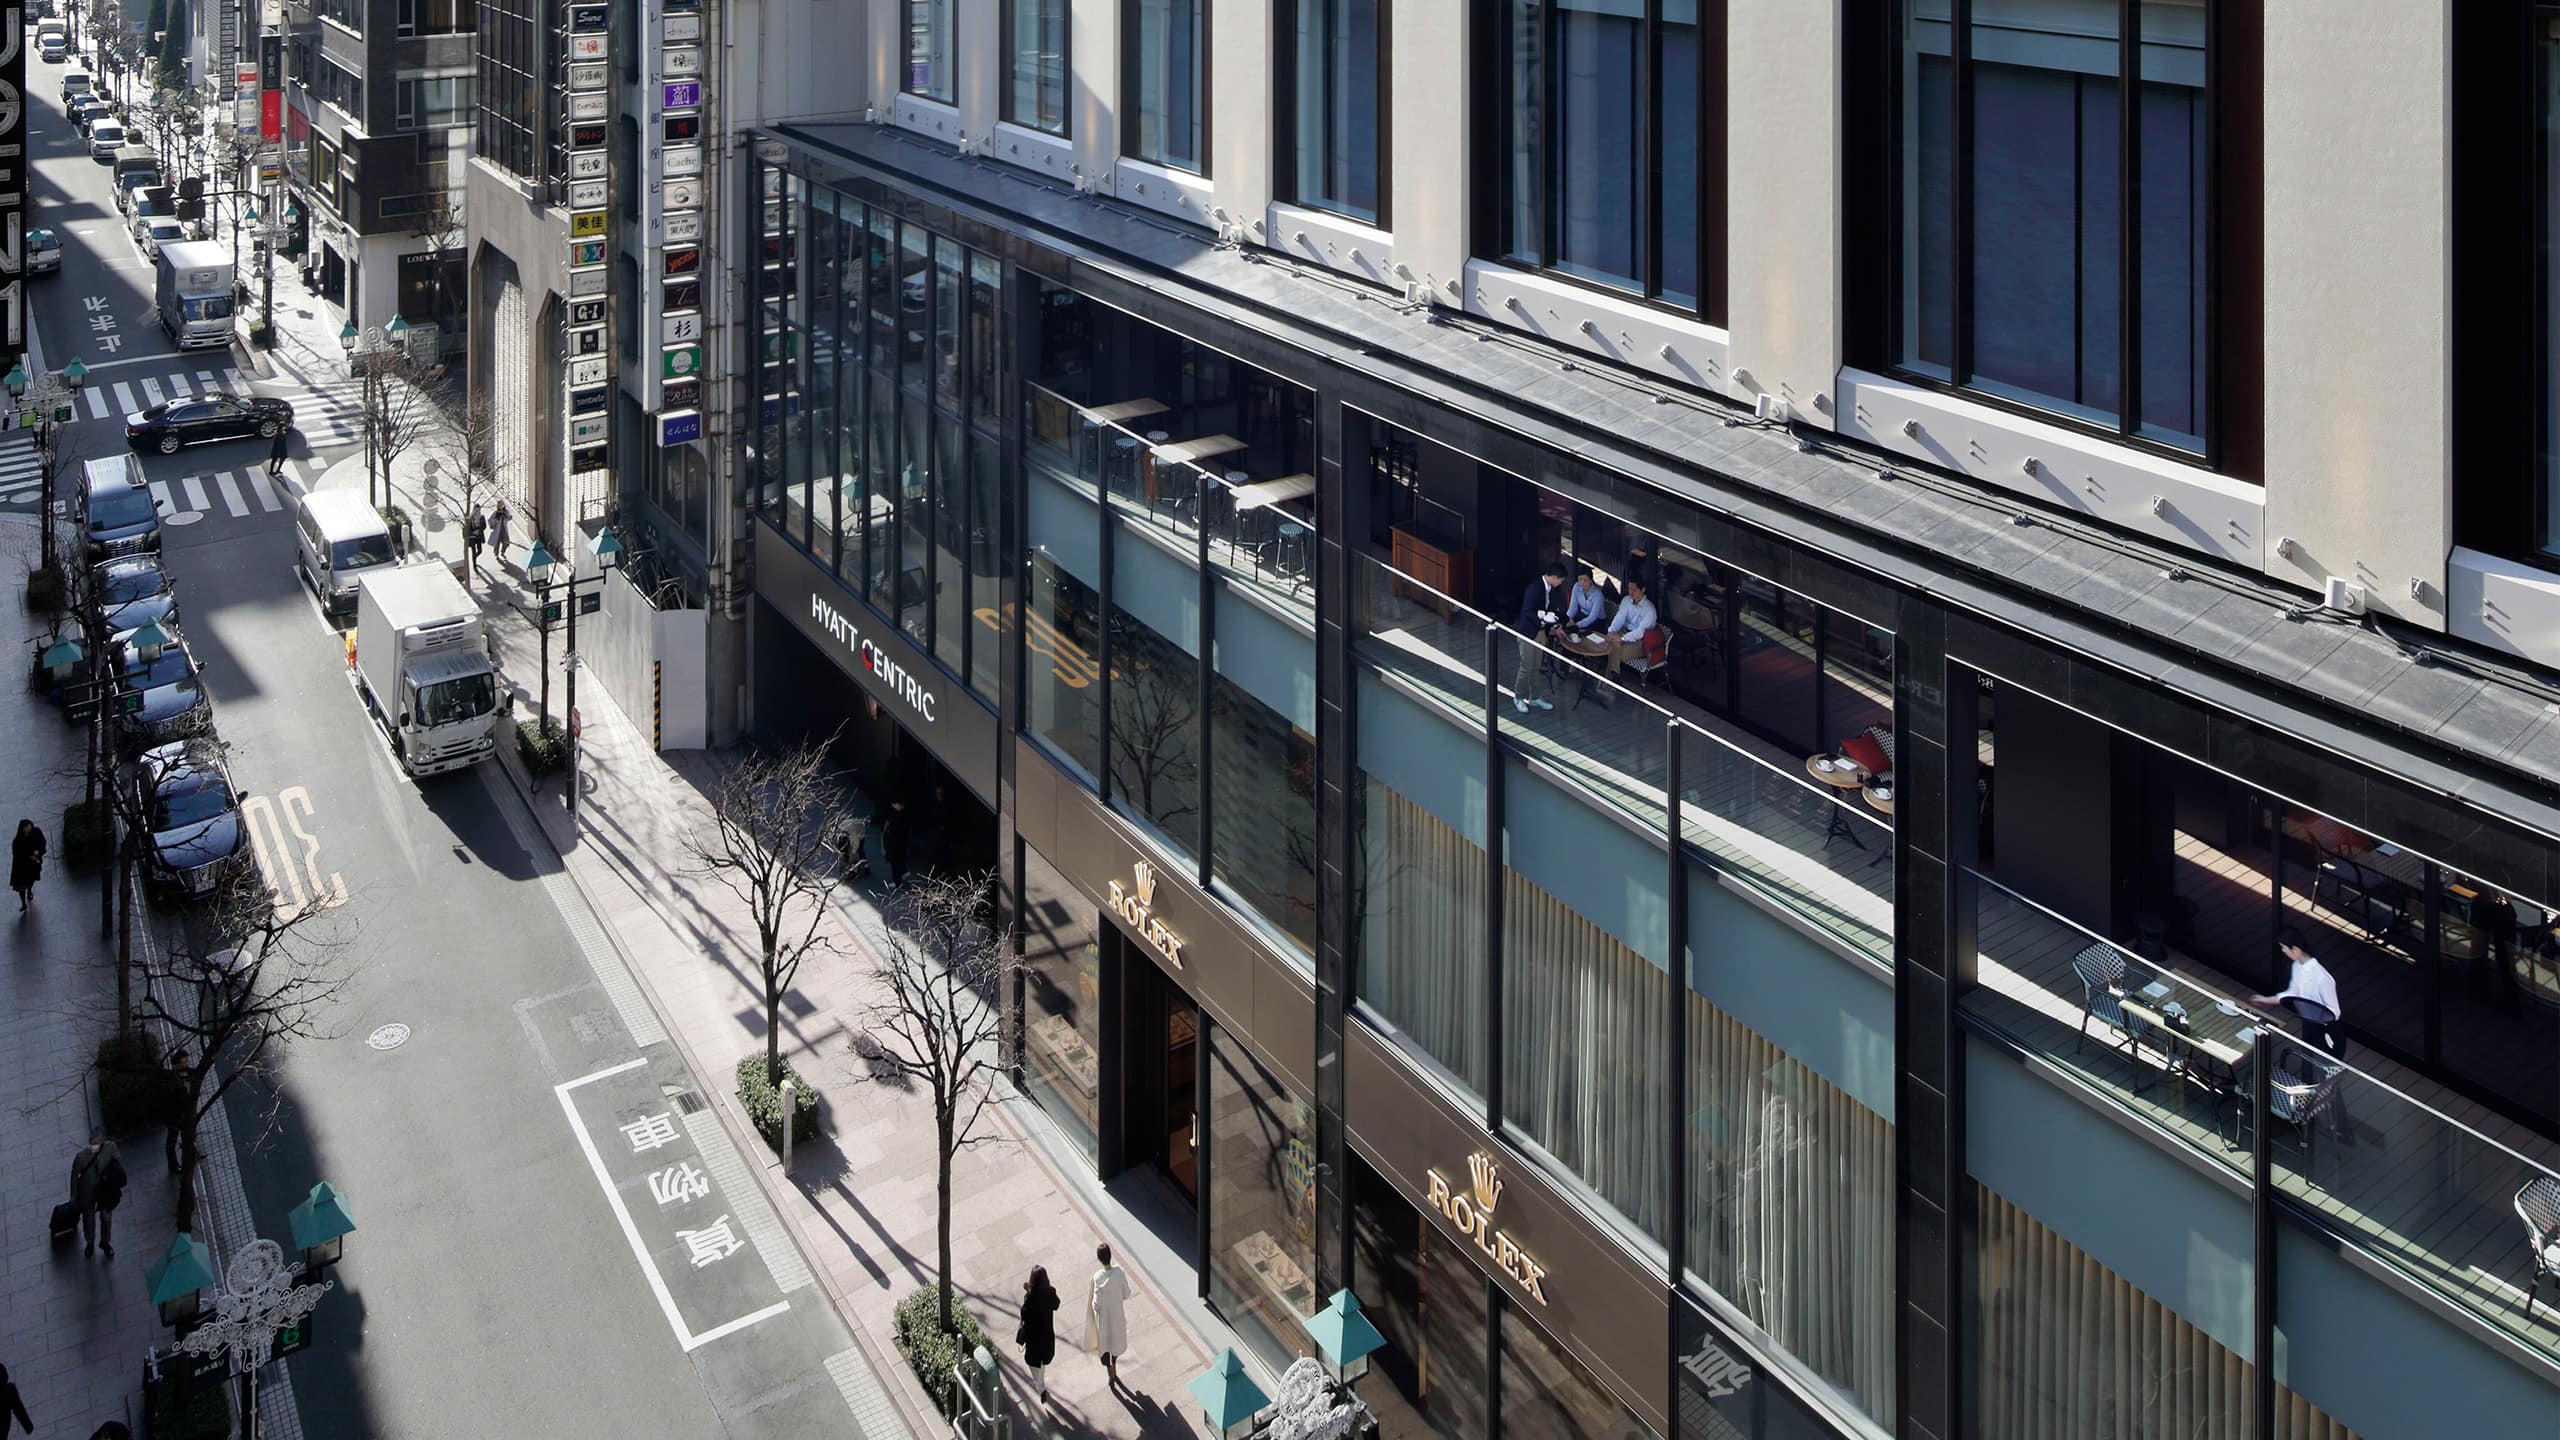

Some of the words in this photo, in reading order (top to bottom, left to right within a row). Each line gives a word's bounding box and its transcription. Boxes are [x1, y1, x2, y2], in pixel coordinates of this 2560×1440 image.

[576, 216, 603, 230] 美佳
[674, 320, 692, 338] 杉
[812, 592, 858, 653] HYATT
[862, 638, 935, 722] CENTRIC
[1108, 880, 1183, 970] ROLEX
[1427, 1168, 1548, 1307] ROLEX
